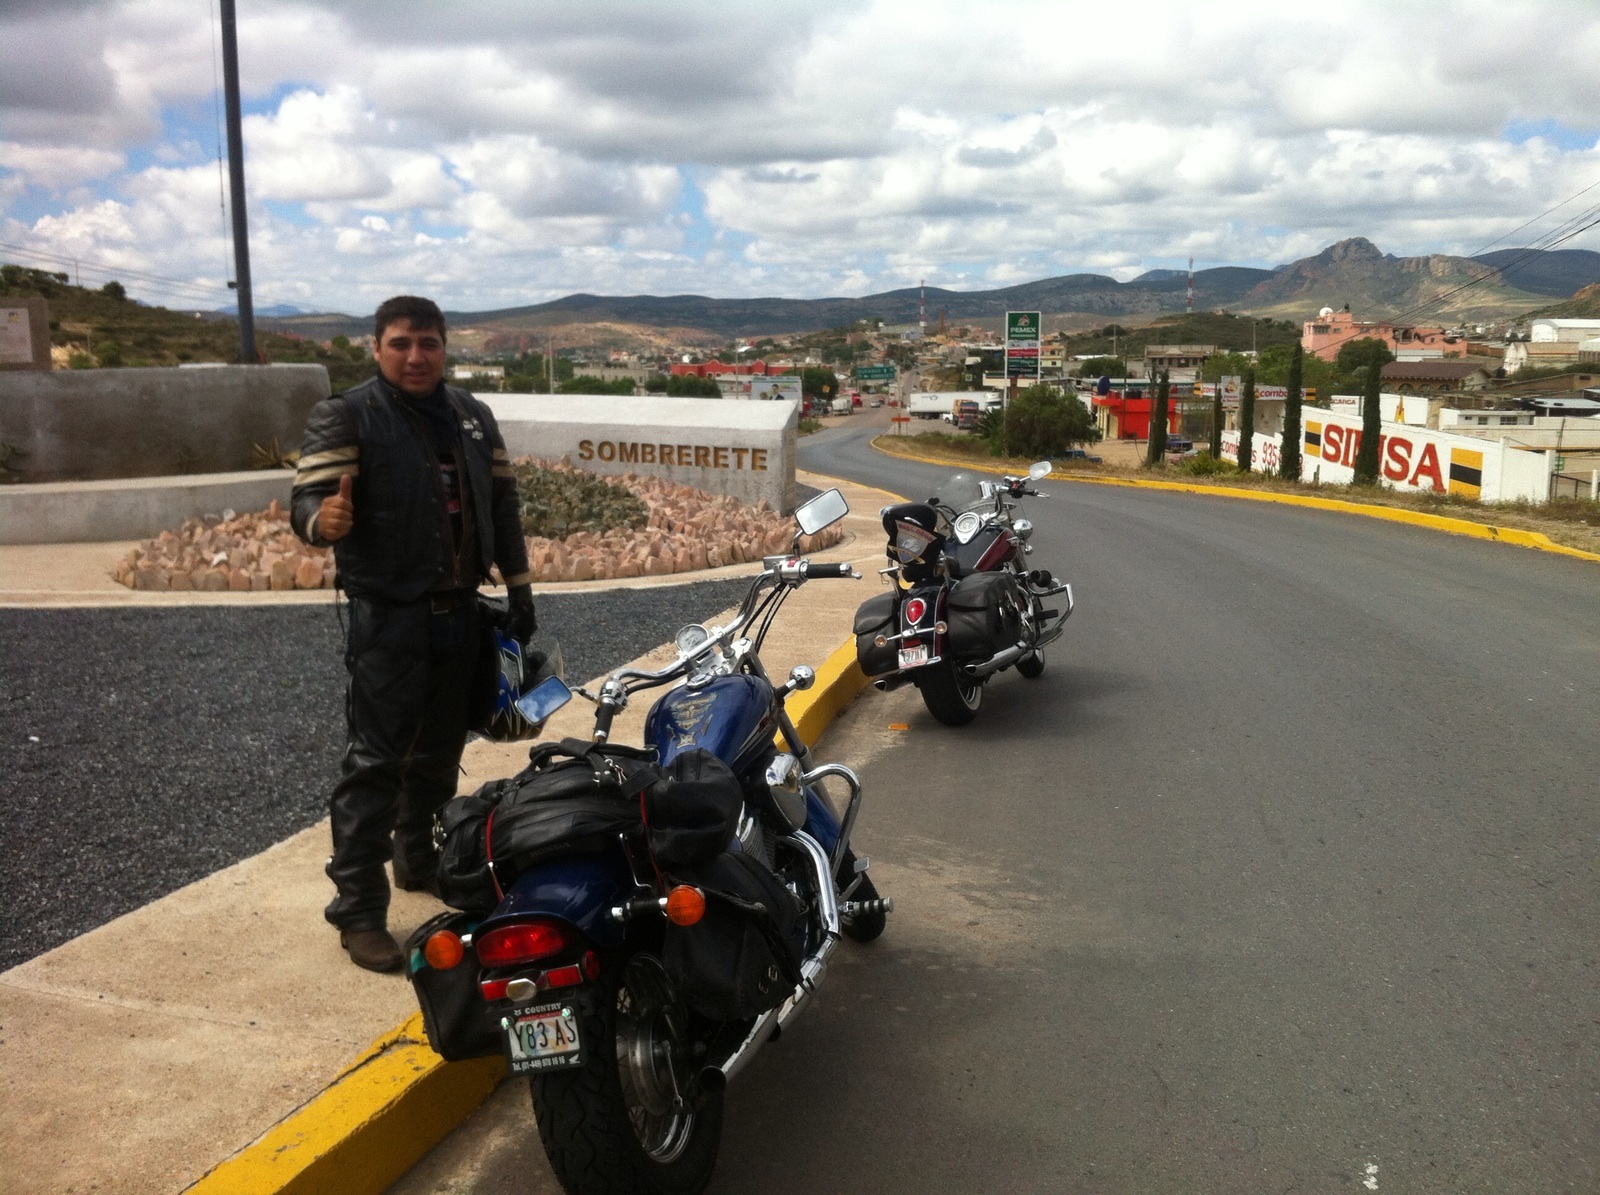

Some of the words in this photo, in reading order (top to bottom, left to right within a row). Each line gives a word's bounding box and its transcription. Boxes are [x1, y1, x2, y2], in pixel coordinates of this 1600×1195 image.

[578, 439, 768, 471] SOMBRERETE
[525, 1002, 562, 1015] COUNTRY
[512, 1021, 548, 1051] Y83
[555, 1018, 577, 1046] AS
